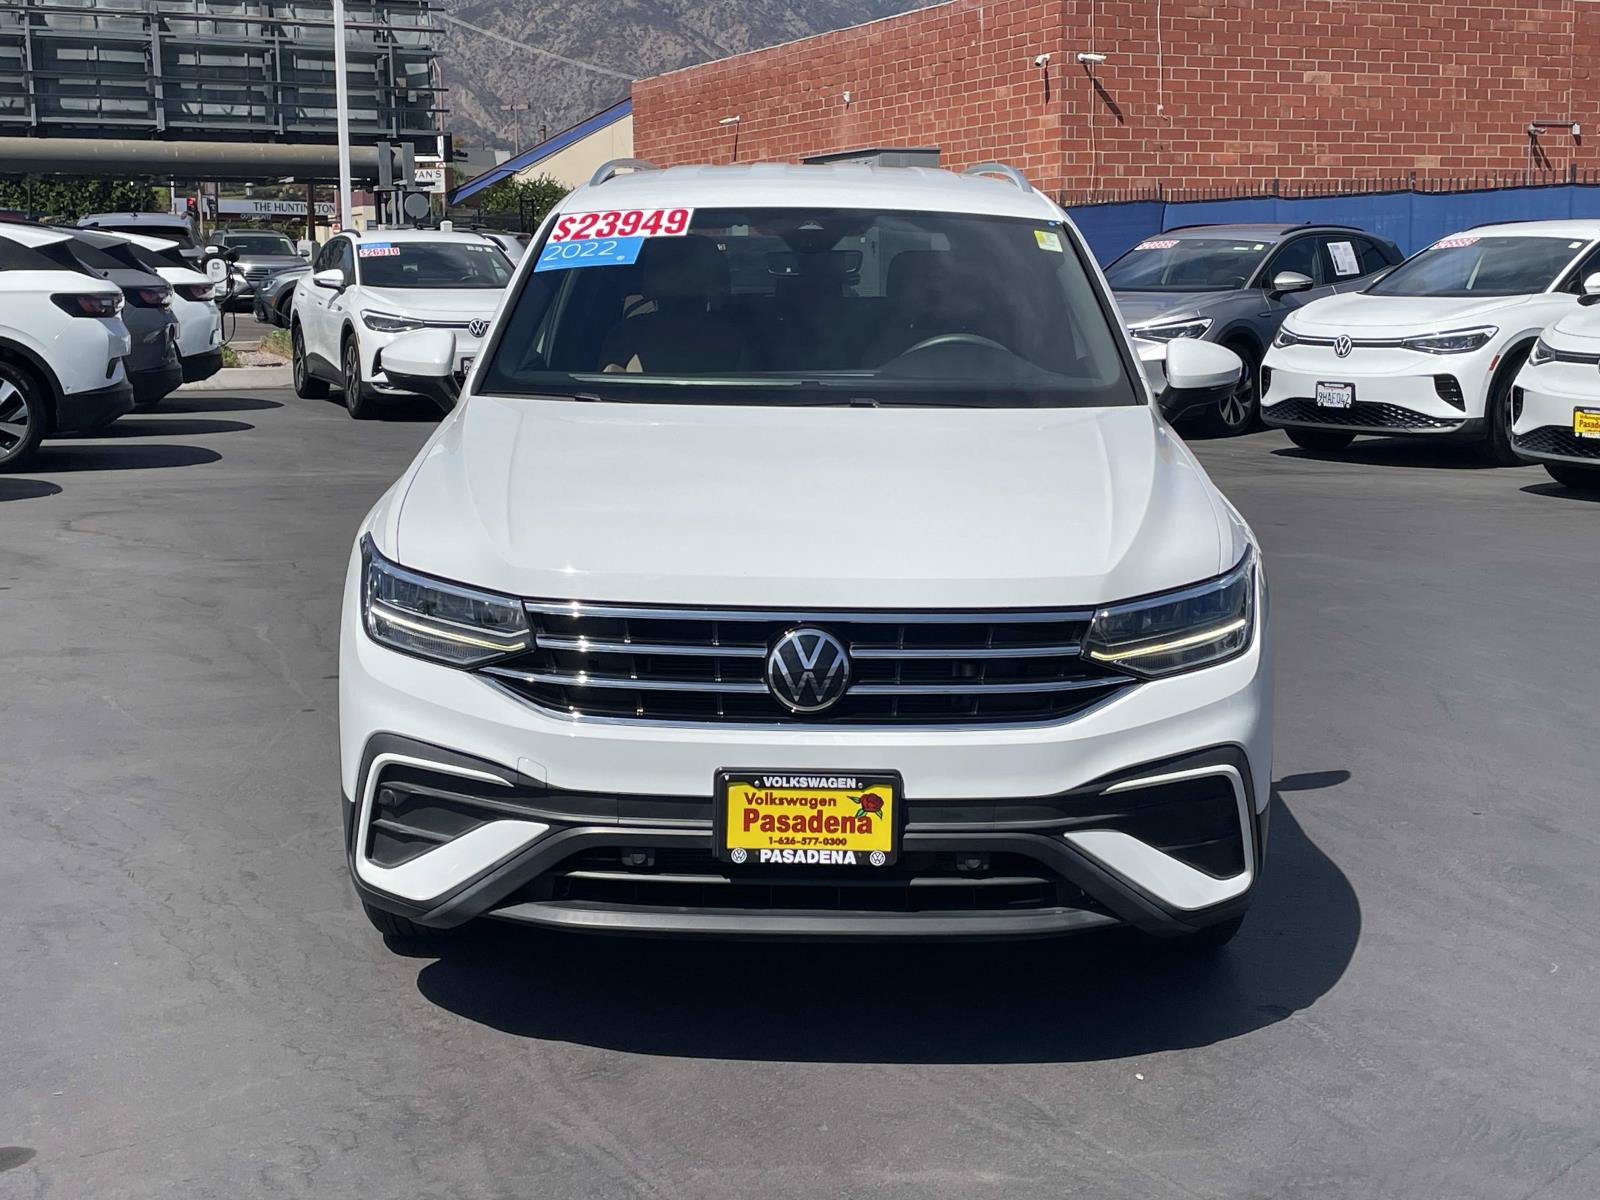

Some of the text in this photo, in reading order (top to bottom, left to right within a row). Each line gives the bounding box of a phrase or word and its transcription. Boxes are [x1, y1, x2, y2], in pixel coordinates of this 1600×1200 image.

[253, 201, 336, 214] THE HUNTINTON
[553, 208, 689, 242] $23949
[543, 240, 618, 261] 2022
[763, 776, 857, 789] VOLKSWAGEN
[743, 792, 837, 808] Volkswagen
[743, 808, 873, 834] Pasadena
[768, 836, 847, 847] 1-626-577-0300
[760, 849, 857, 865] PASADENA
